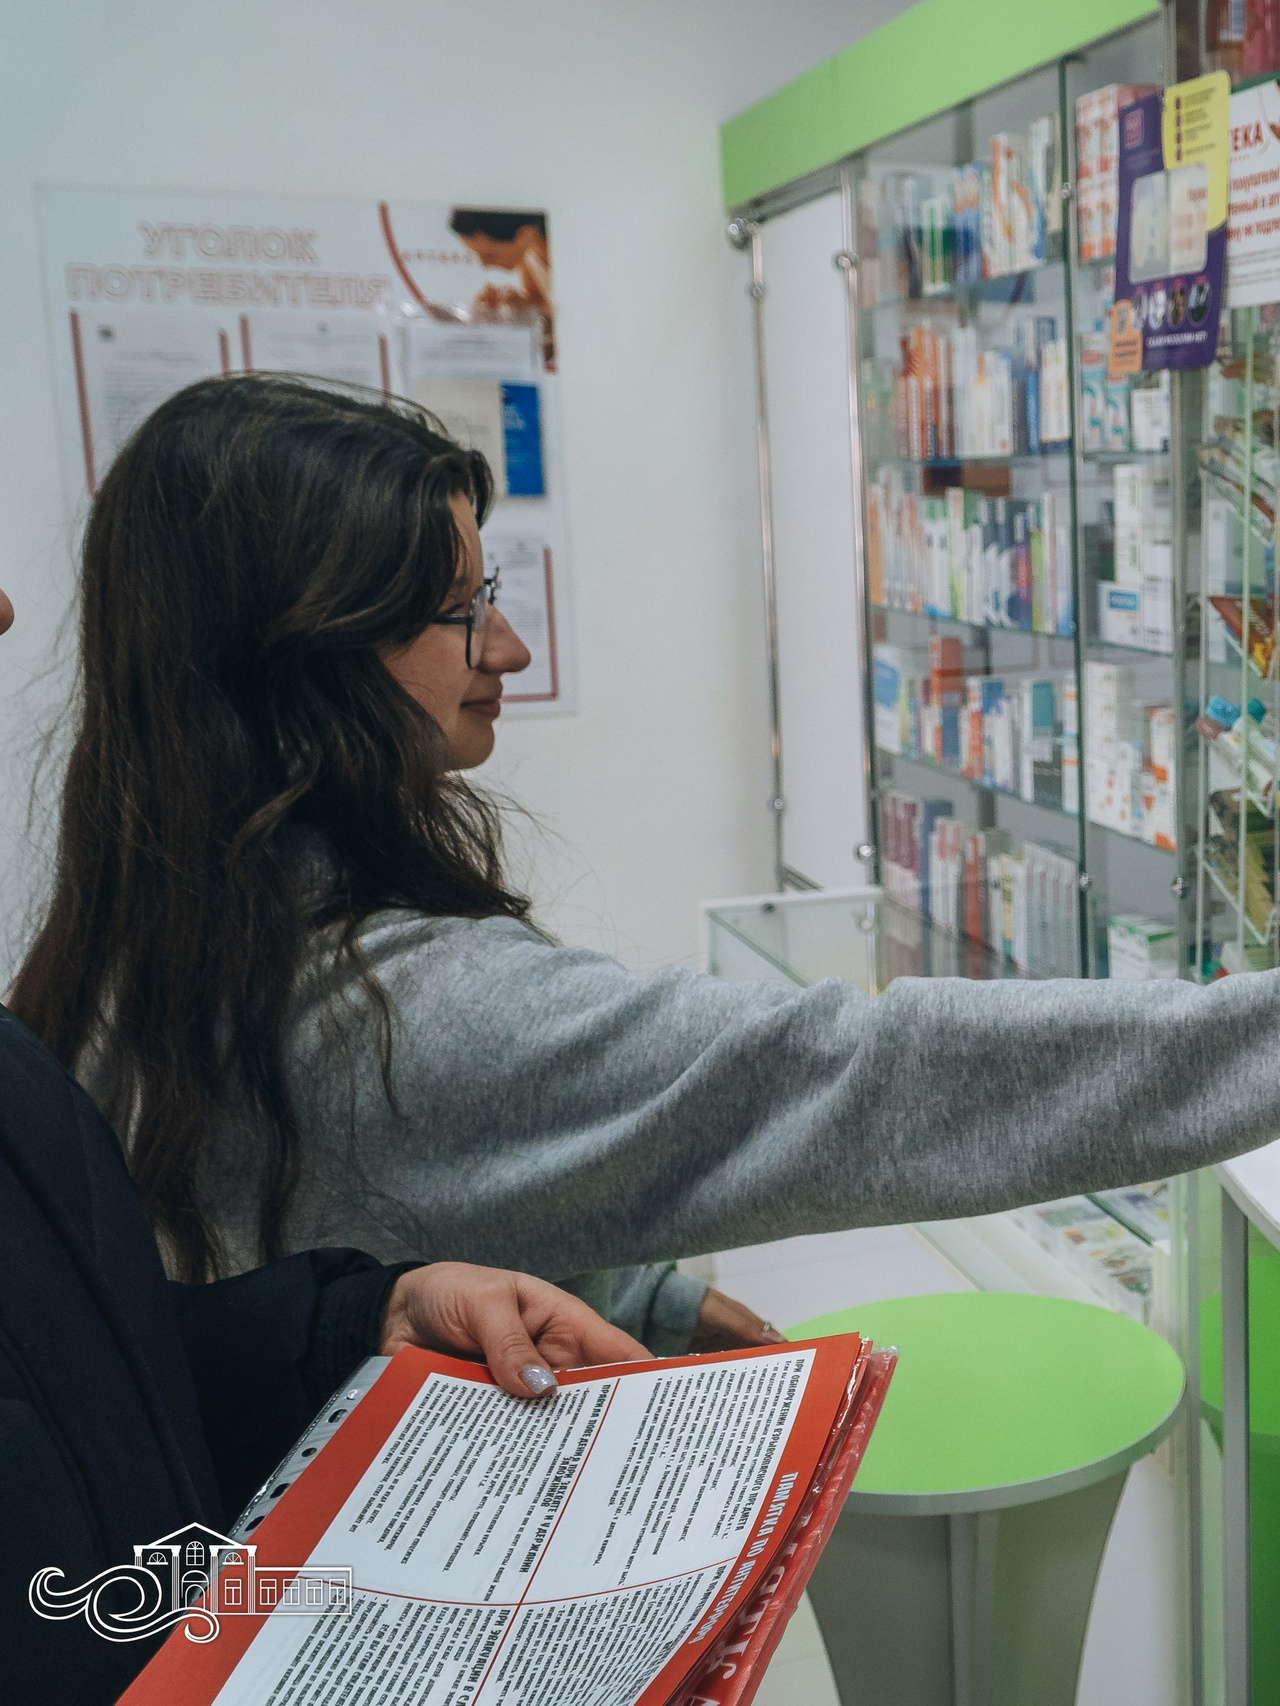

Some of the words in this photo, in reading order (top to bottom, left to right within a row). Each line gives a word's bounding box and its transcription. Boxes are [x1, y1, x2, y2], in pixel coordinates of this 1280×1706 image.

[137, 220, 319, 264] УГОЛОК
[65, 261, 393, 309] ПОТРЕБИТЕЛЯ
[793, 1358, 805, 1373] ПРИ
[590, 1384, 612, 1418] ПРАВИЛА
[775, 1374, 801, 1427] ОБНАРУЖЕНИИ
[570, 1419, 598, 1462] ПОВЕДЕНИЯ
[751, 1427, 783, 1492] ВЗРЫВООПАСНОГО
[540, 1456, 574, 1508] ЗАЛОЖНИКОВ
[563, 1463, 579, 1479] ПРИ
[547, 1480, 571, 1513] ЗАХВАТЕ
[734, 1492, 759, 1532] ПРЕДМЕТА
[756, 1471, 799, 1537] ПАМЯТКА
[518, 1522, 551, 1573] УДЕРЖАНИИ
[746, 1537, 770, 1558] ПО
[494, 1609, 511, 1627] ПРИ
[467, 1629, 502, 1683] ЭВАКУАЦИИ
